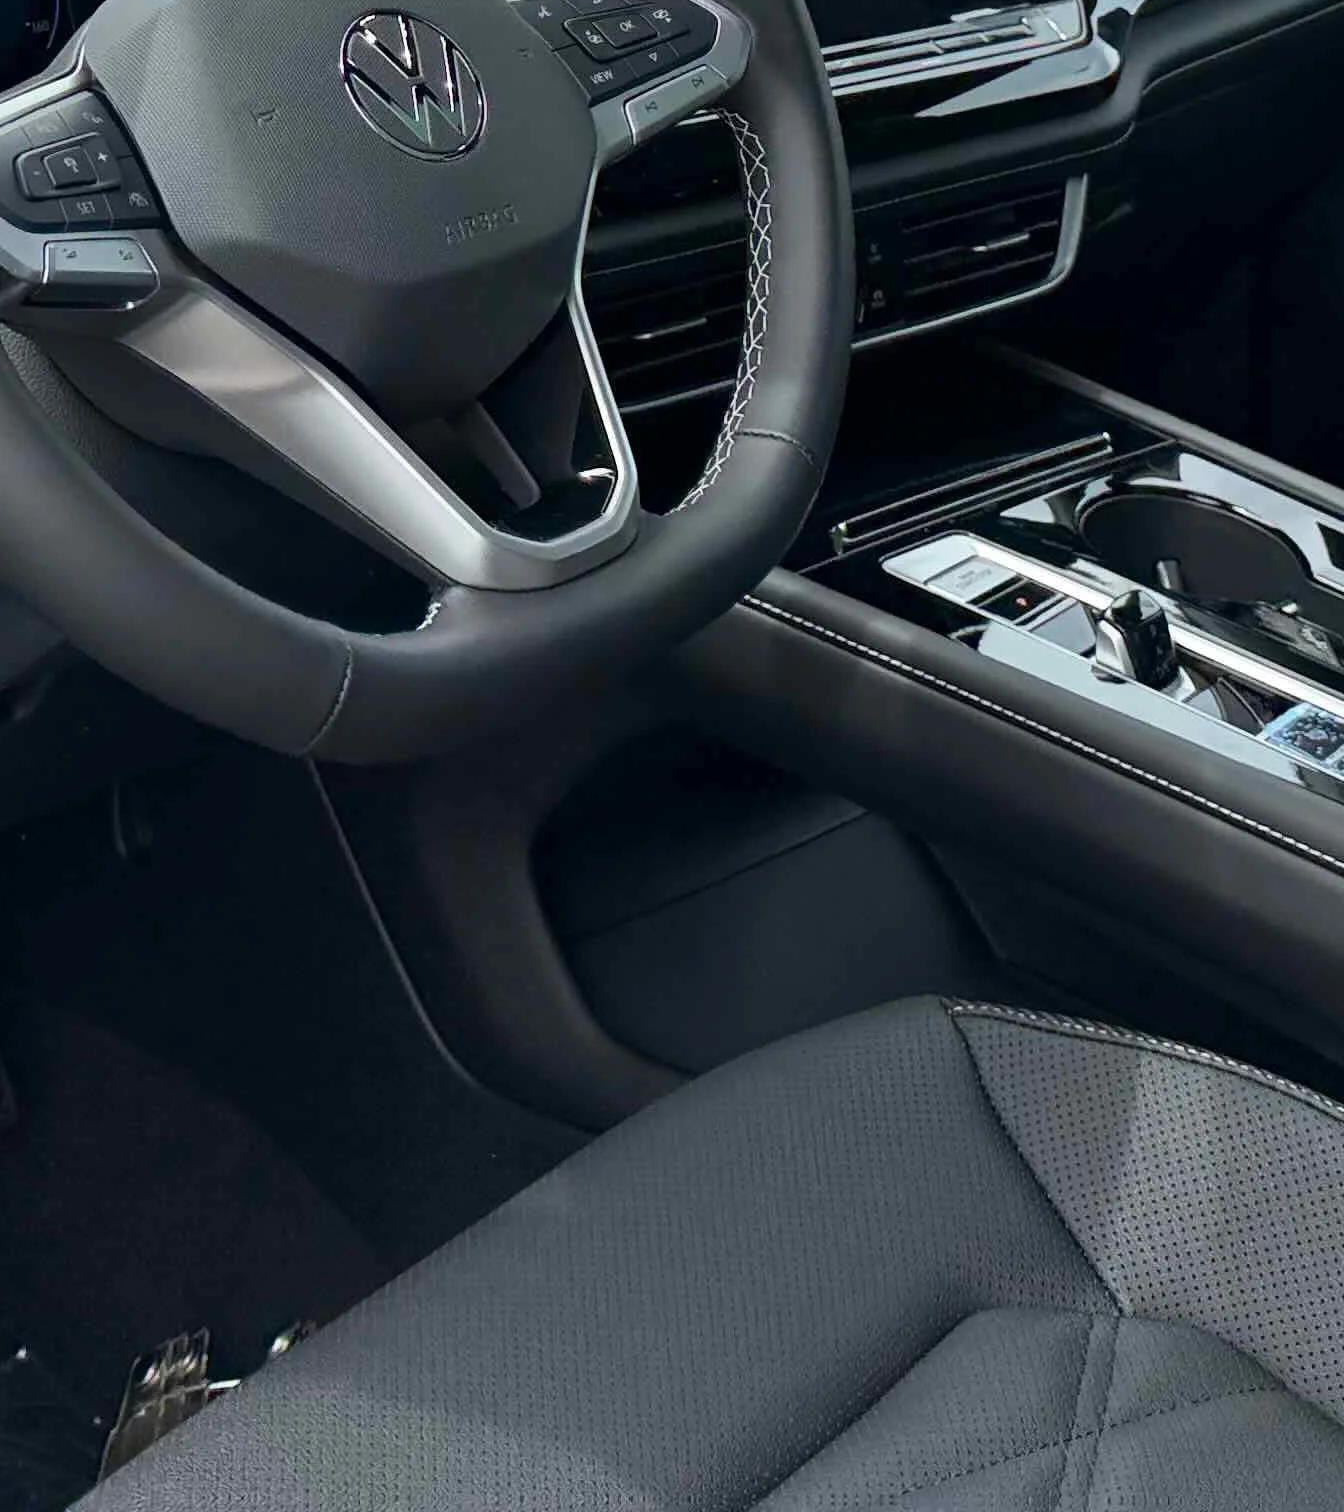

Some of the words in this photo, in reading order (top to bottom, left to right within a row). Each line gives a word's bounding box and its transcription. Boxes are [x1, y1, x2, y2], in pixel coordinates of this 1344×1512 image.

[619, 20, 637, 32] OK
[590, 69, 614, 85] VIEW
[76, 200, 96, 215] SET
